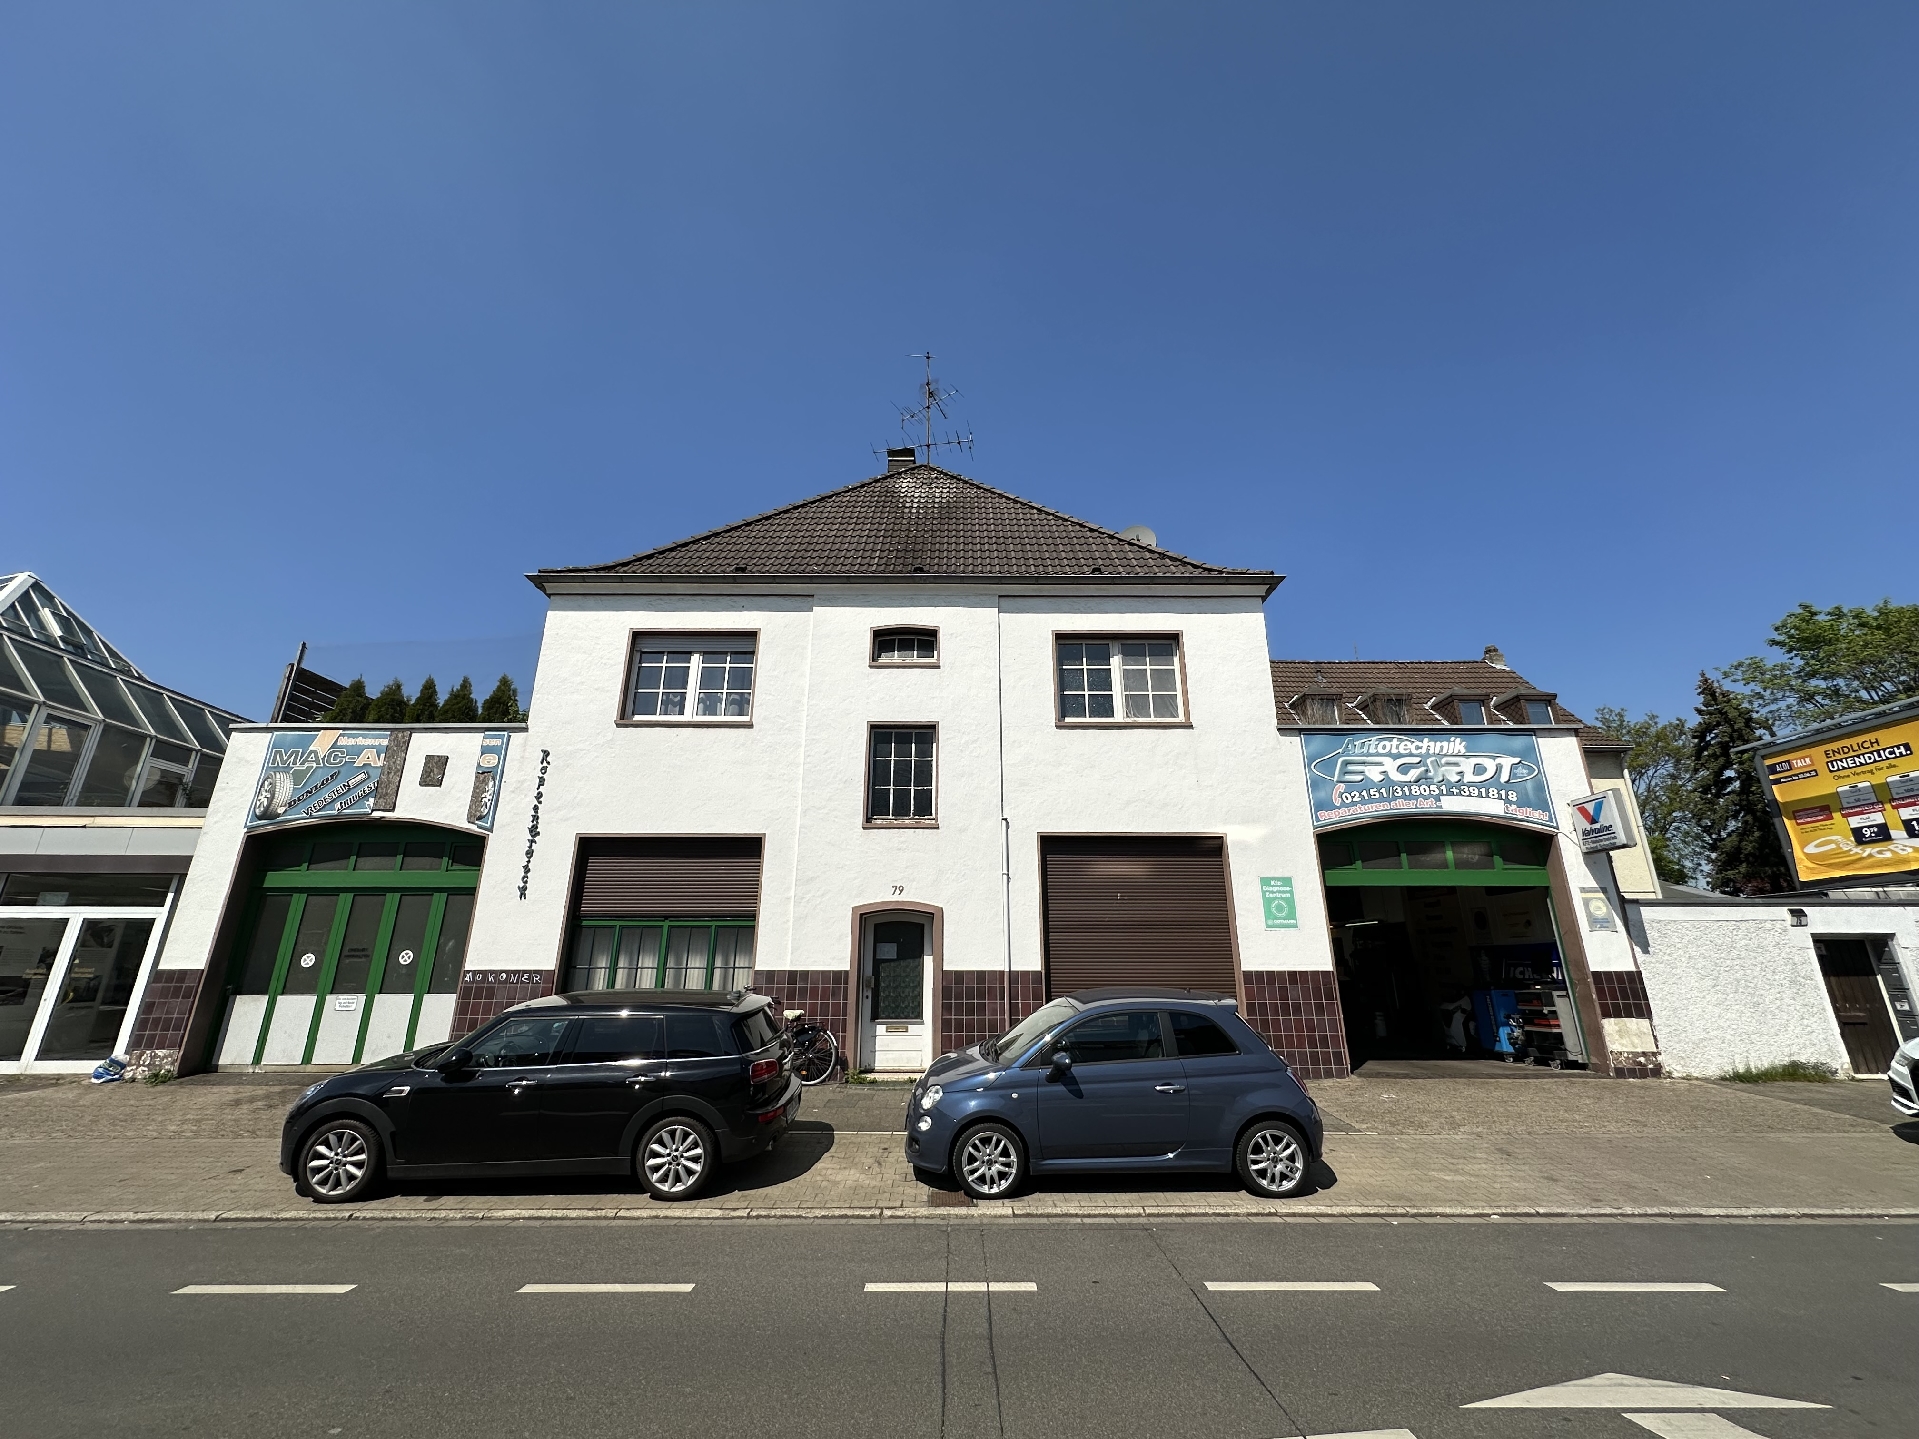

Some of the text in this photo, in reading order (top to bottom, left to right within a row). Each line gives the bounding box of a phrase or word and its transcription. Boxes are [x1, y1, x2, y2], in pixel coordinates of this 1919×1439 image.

[1341, 736, 1467, 755] Autotechnik
[1824, 738, 1880, 759] ENDLICH
[268, 748, 385, 767] MAC-A
[1775, 757, 1812, 772] ALDI TALK
[1828, 746, 1911, 771] UNENDLICH.
[1333, 756, 1522, 784] ERGARDT
[1832, 773, 1851, 781] Ohne
[1850, 767, 1875, 777] Vertrag
[287, 770, 339, 809] DUNLOP
[301, 779, 352, 818] VREDESTEIN
[1341, 784, 1518, 804] 02151/318051+391818
[1317, 801, 1391, 820] Reparaturen
[1390, 799, 1417, 810] aller
[1418, 797, 1436, 808] Art
[1504, 803, 1549, 821] täglich!
[1581, 824, 1613, 838] Valvoline
[891, 885, 905, 896] 79
